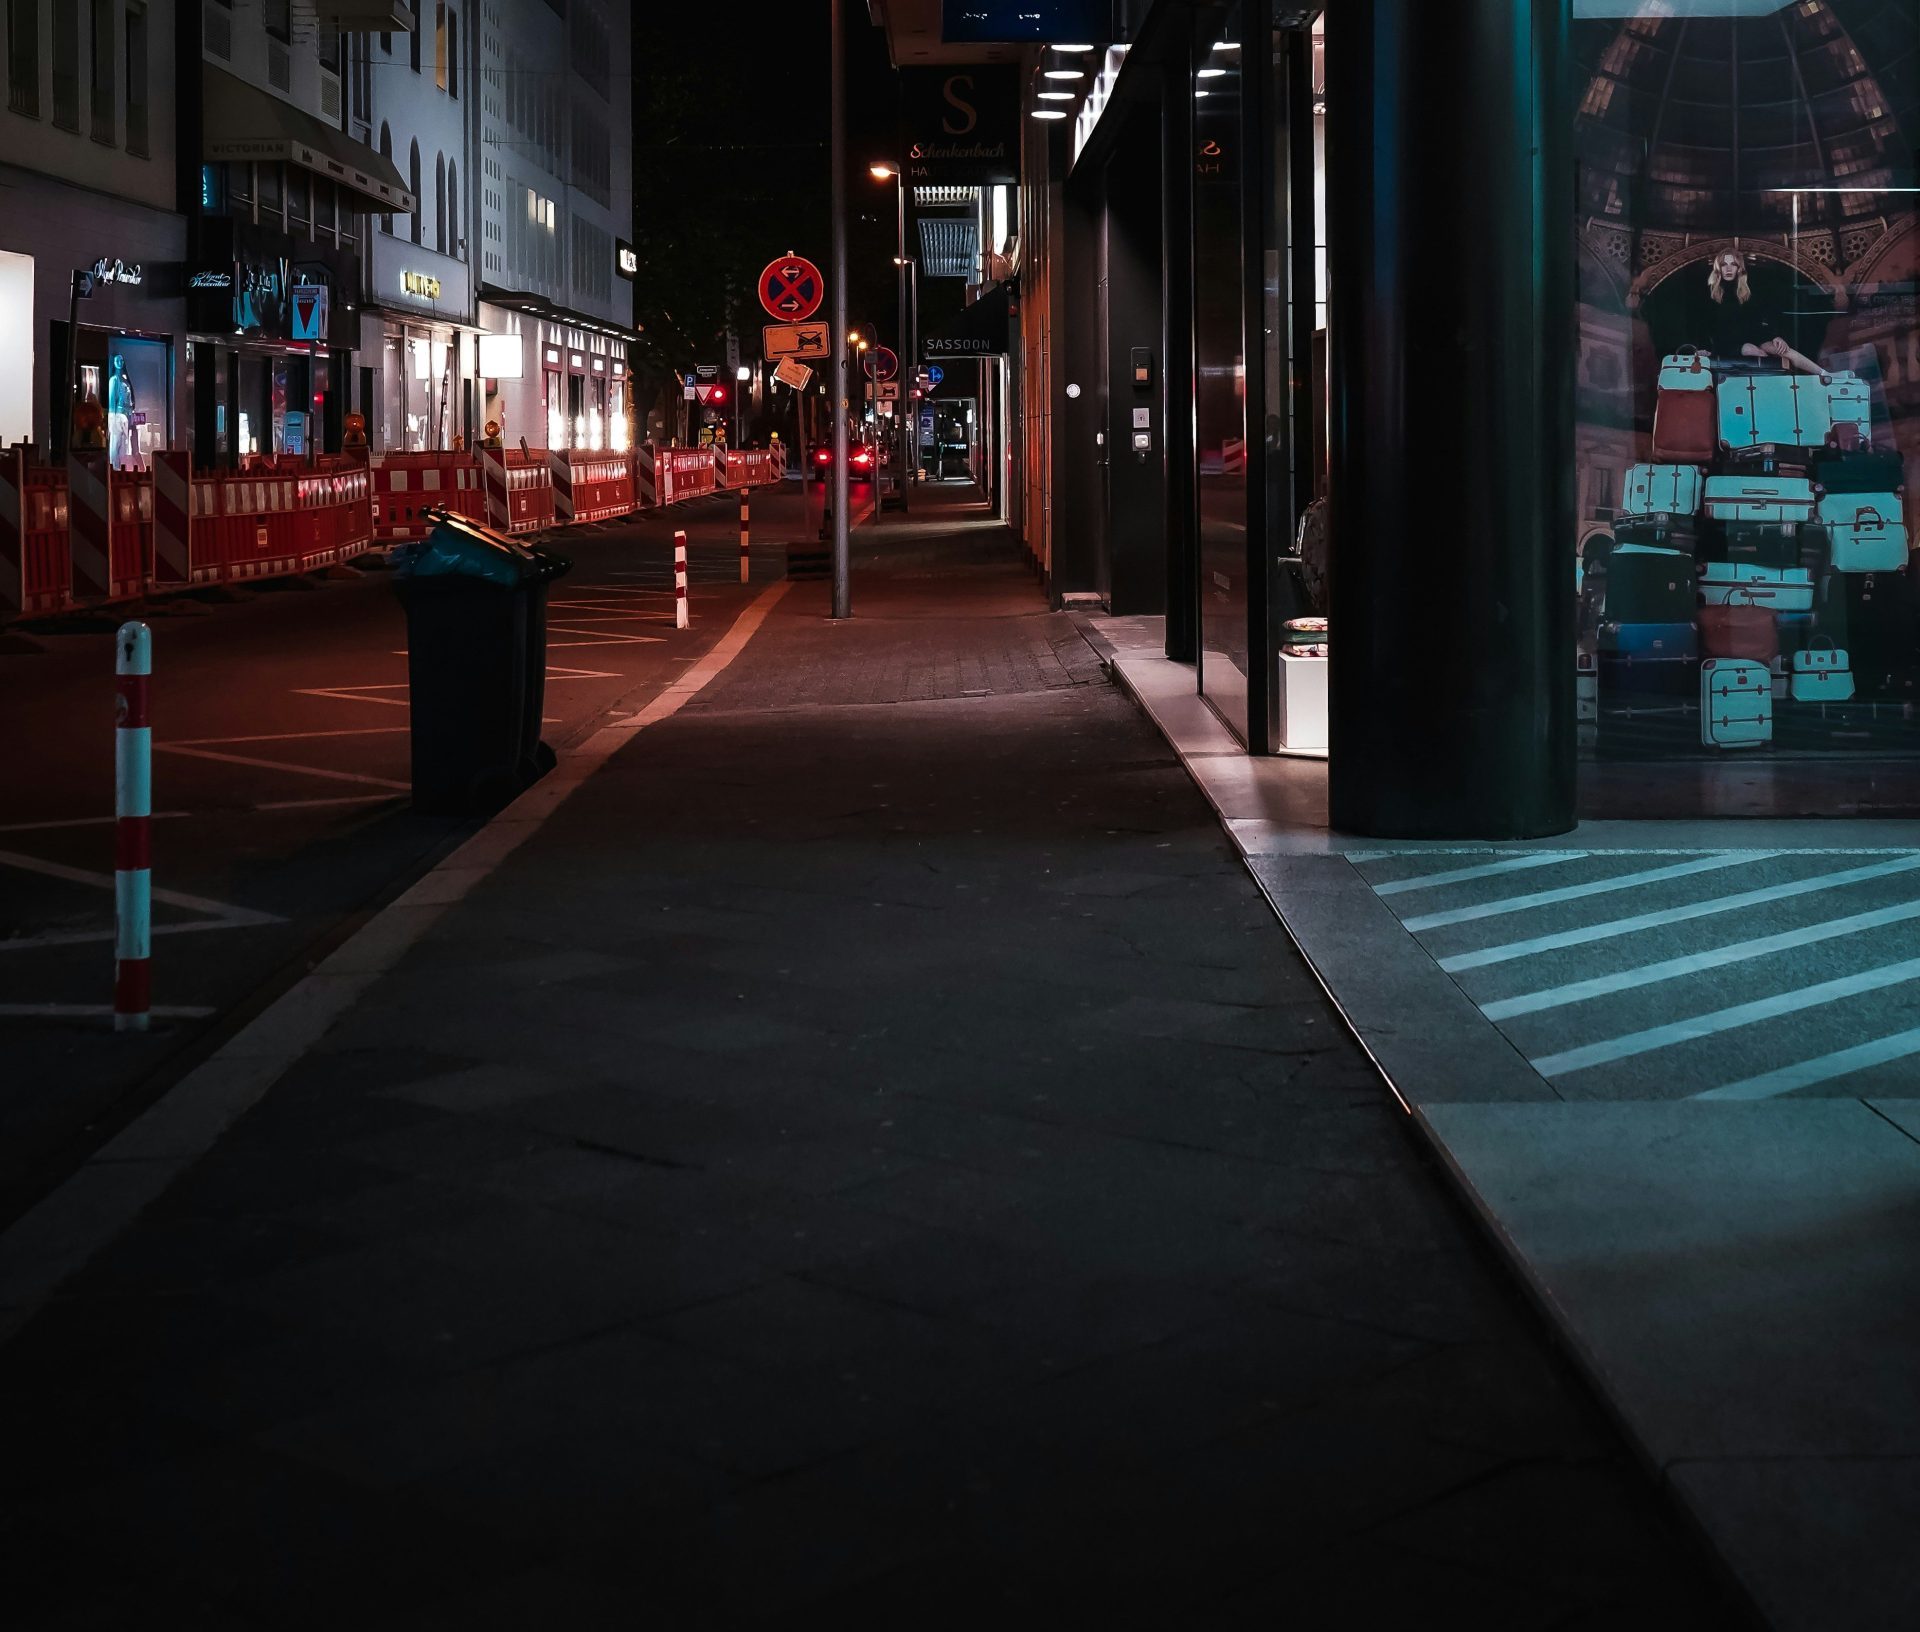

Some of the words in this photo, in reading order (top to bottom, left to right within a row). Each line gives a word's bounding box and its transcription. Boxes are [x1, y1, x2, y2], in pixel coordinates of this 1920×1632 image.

[942, 74, 977, 135] S
[212, 143, 284, 153] VICTORIAN
[910, 142, 1005, 159] Schenkenbach
[926, 339, 991, 350] SASSOON
[686, 376, 693, 386] P
